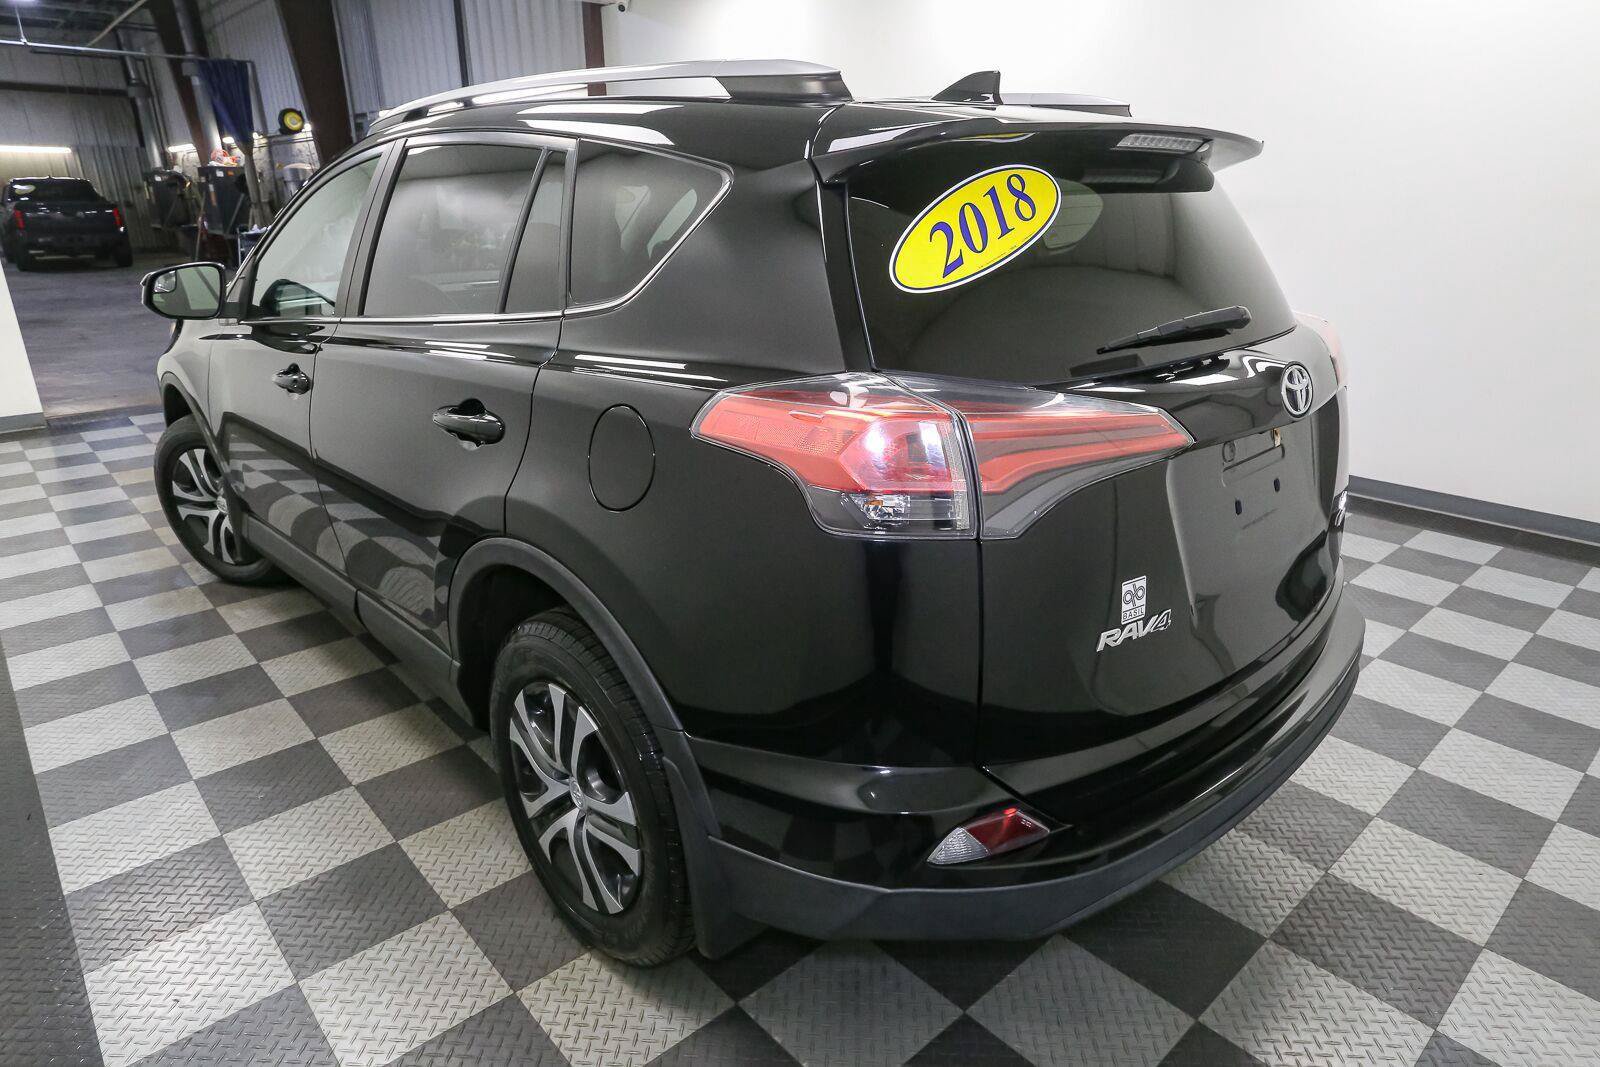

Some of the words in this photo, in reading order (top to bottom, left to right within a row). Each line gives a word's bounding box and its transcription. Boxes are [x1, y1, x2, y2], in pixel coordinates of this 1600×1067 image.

[930, 174, 1036, 278] 2018
[1096, 609, 1172, 652] RAV4
[1122, 607, 1145, 620] BASIL
